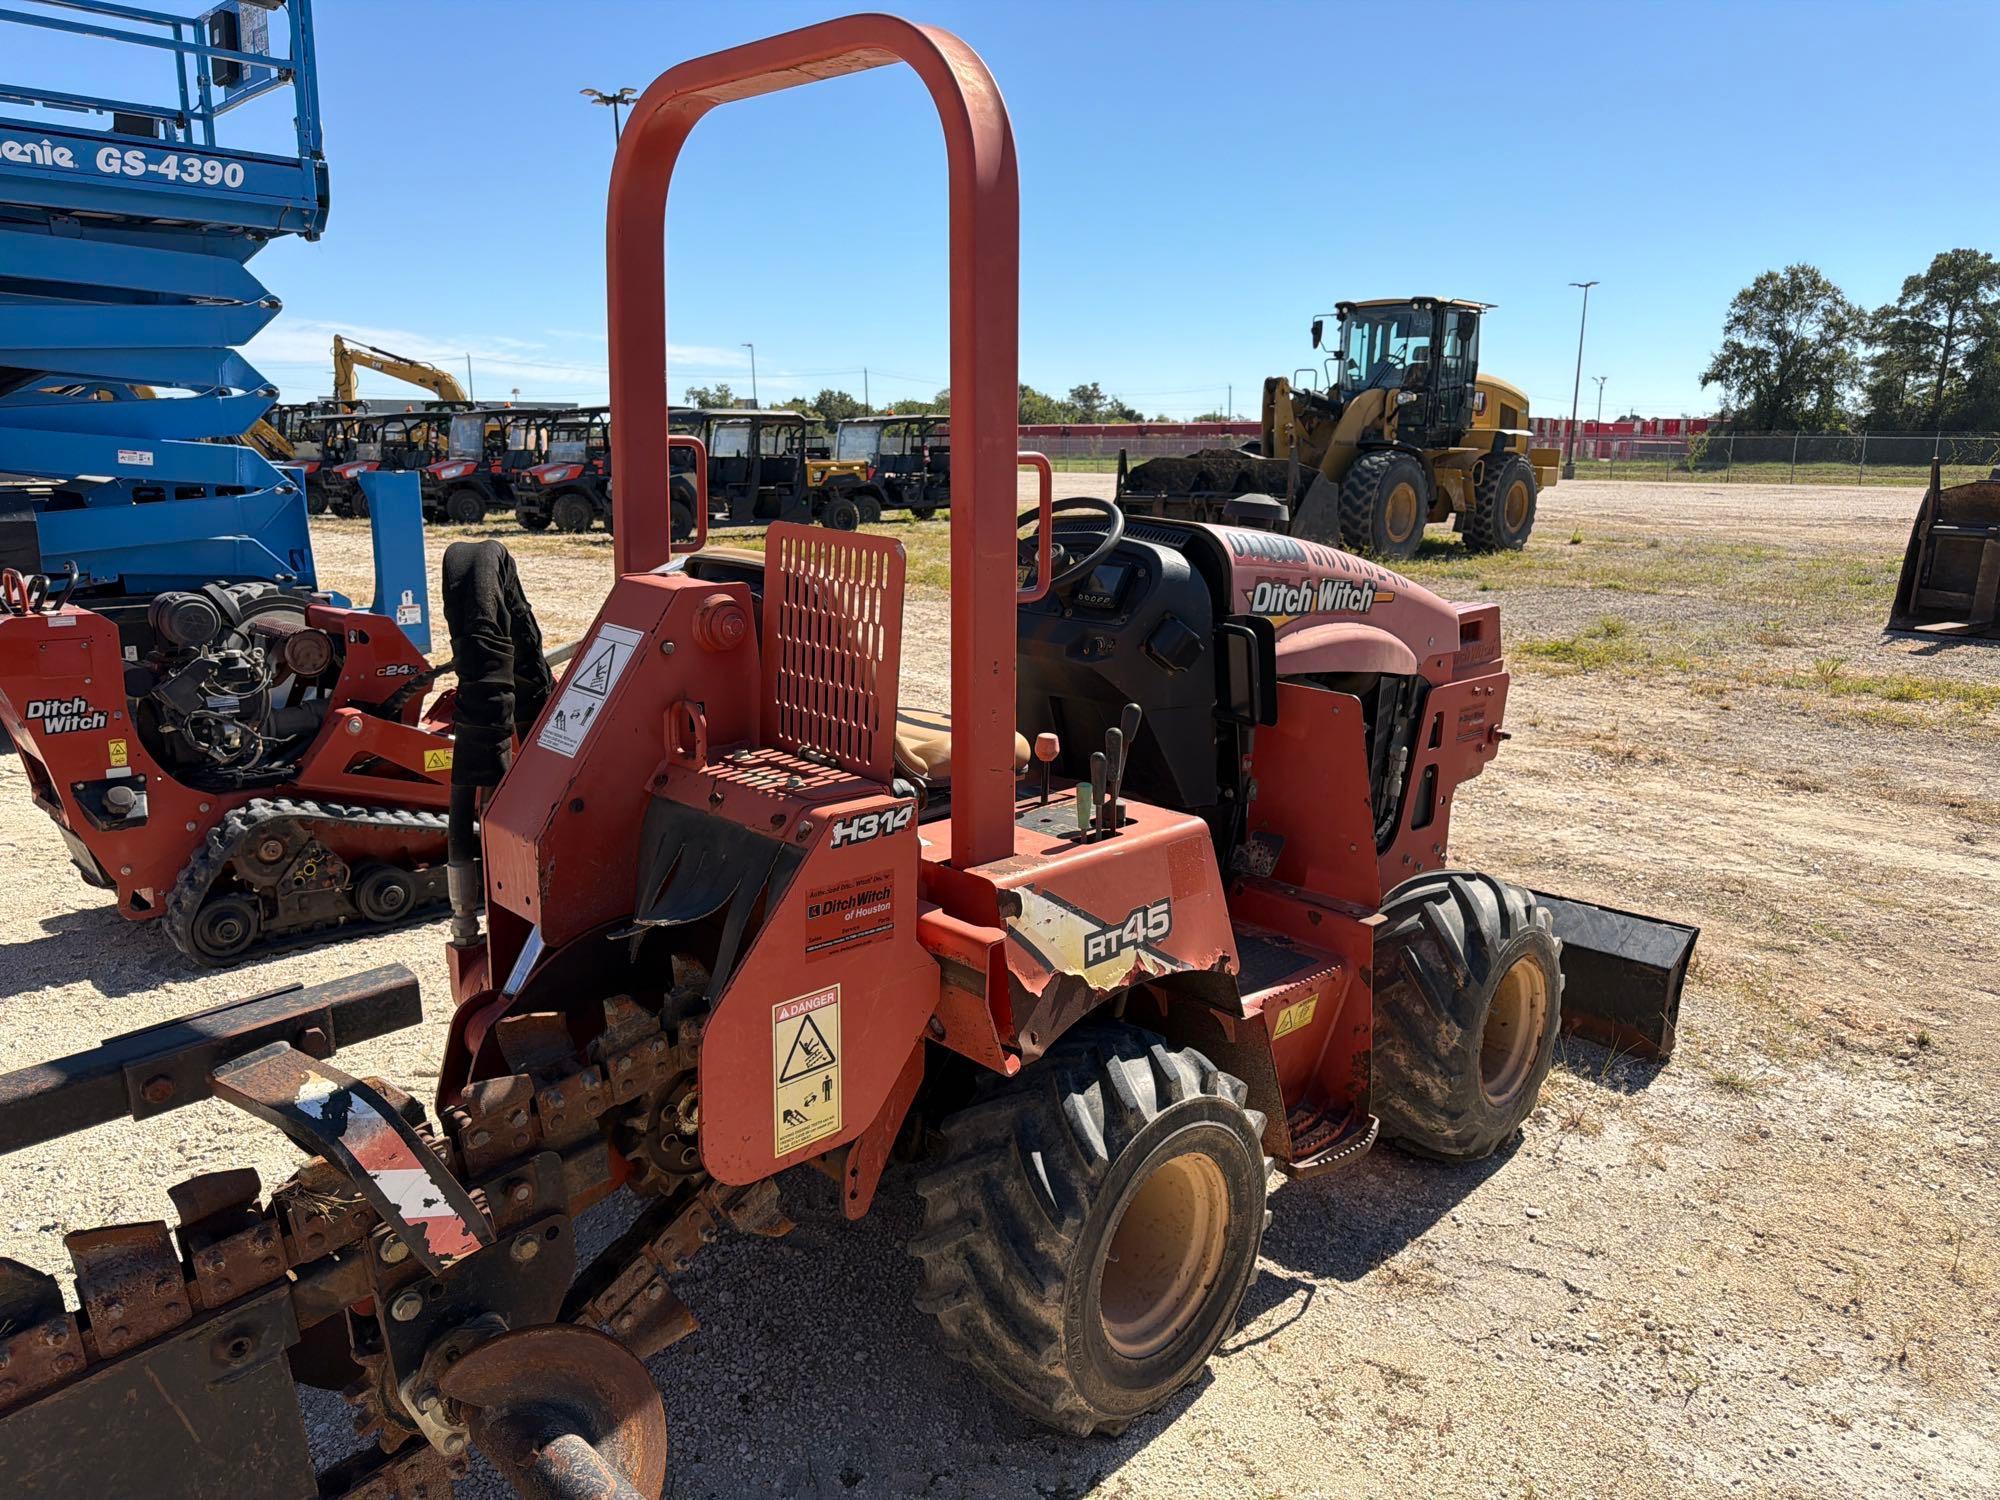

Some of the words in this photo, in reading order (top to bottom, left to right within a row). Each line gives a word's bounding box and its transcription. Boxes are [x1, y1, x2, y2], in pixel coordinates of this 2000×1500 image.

[0, 138, 75, 168] enie
[96, 147, 244, 188] GS-4390
[1251, 580, 1314, 614] Ditch
[1316, 578, 1375, 613] Witch
[27, 697, 87, 719] Ditch
[44, 712, 107, 734] Witch
[832, 805, 914, 845] H314
[822, 895, 857, 916] Ditch
[857, 886, 891, 907] Witch
[844, 909, 855, 921] of
[856, 902, 891, 919] Houston
[1087, 902, 1170, 962] RT45
[790, 992, 835, 1016] DANGER
